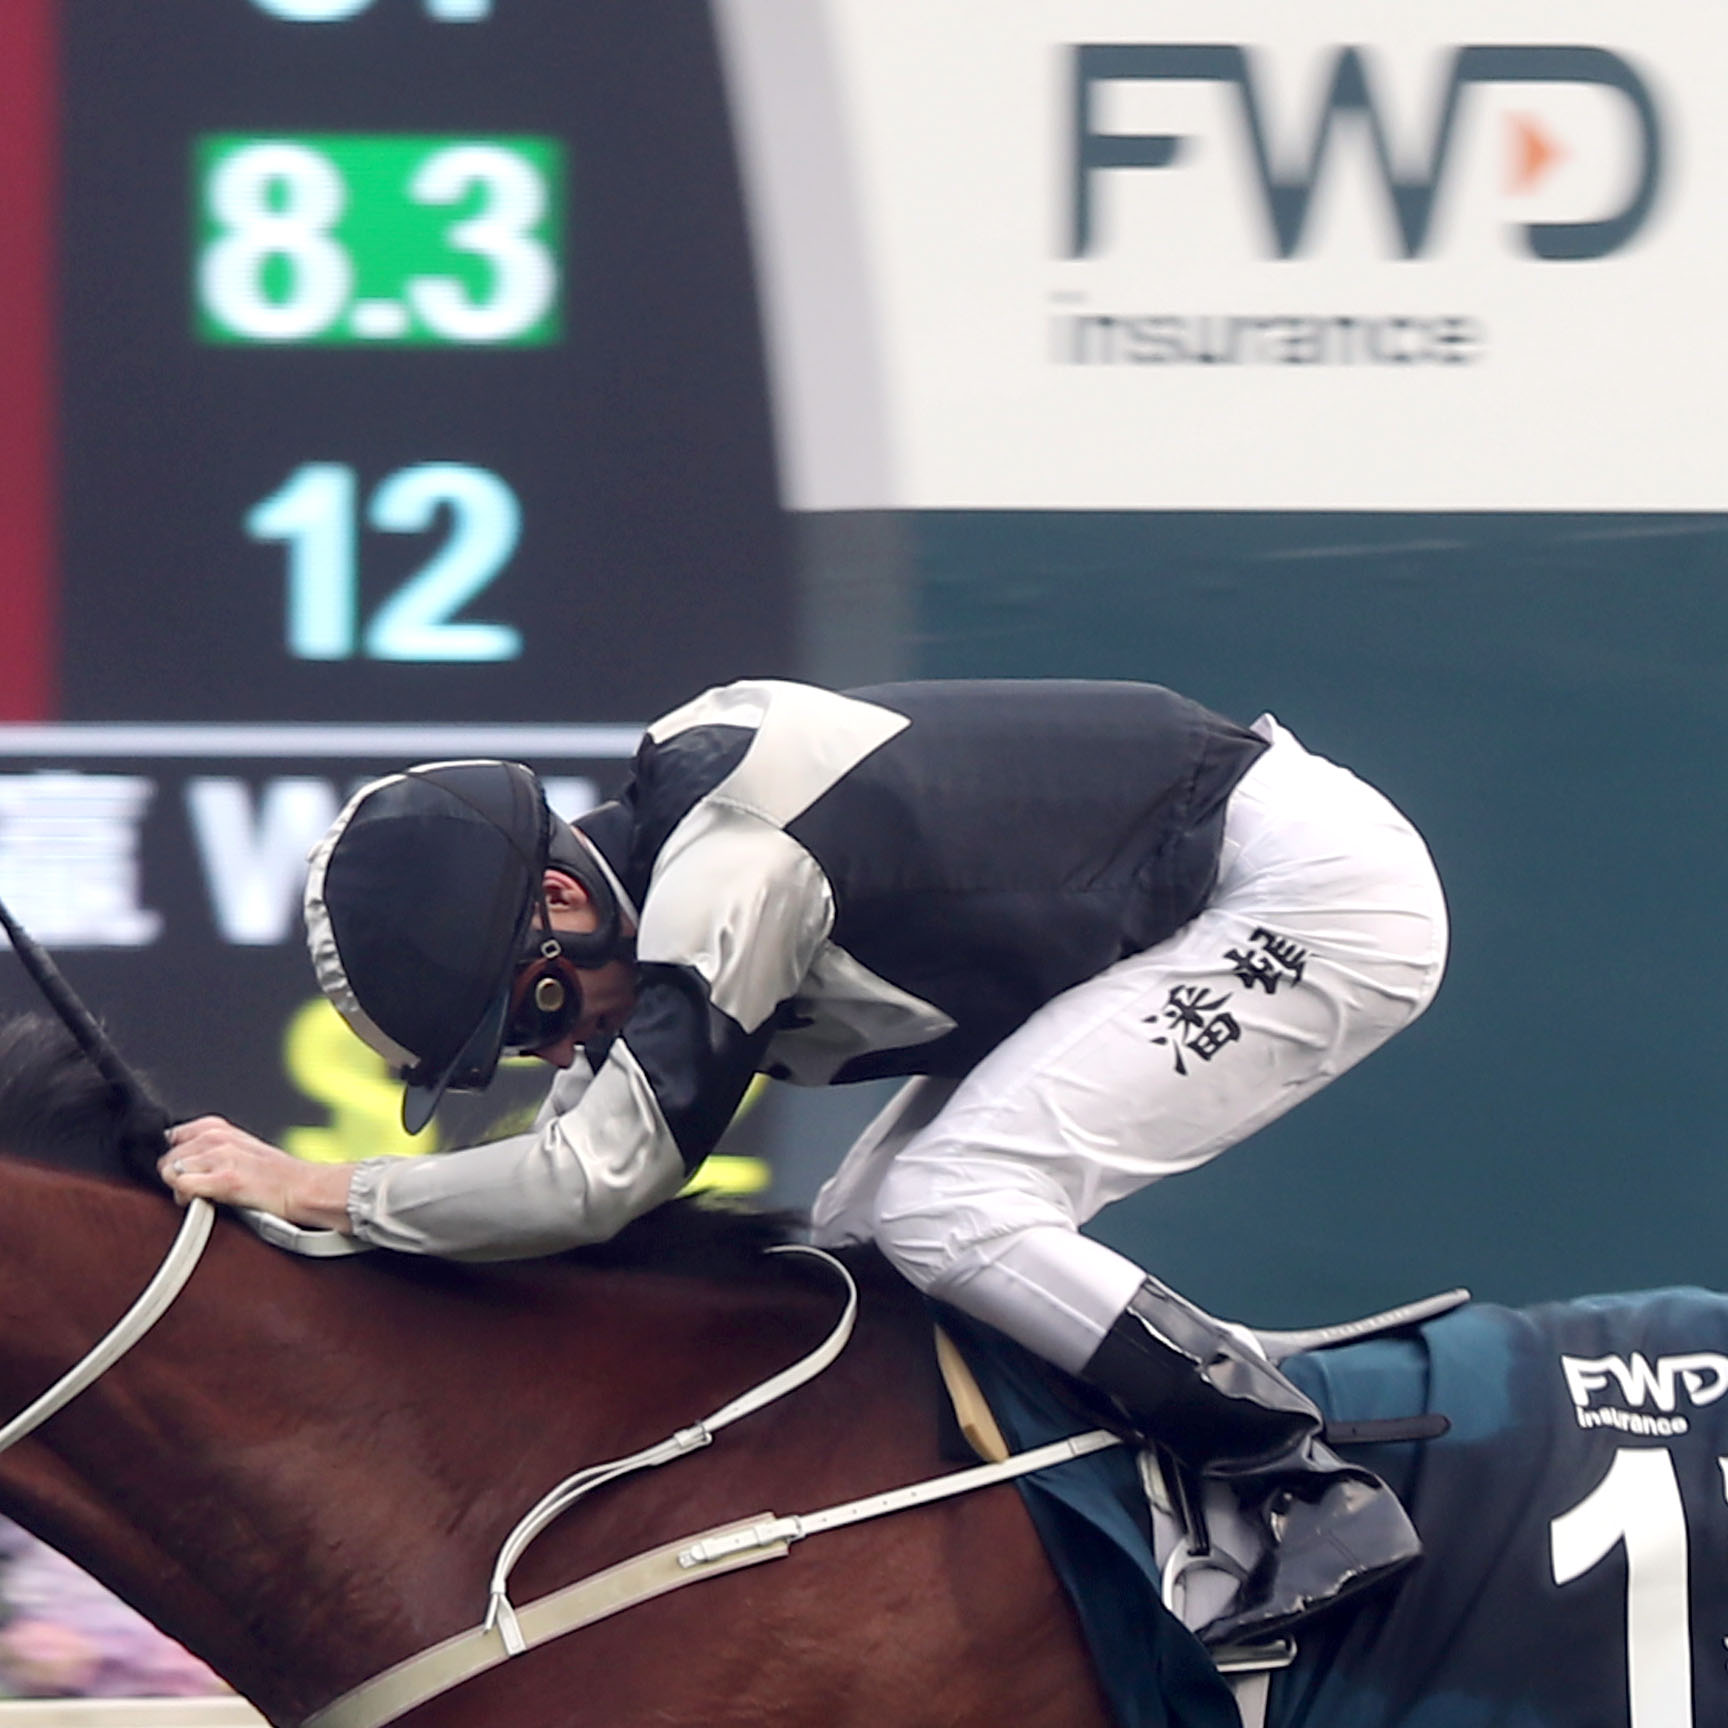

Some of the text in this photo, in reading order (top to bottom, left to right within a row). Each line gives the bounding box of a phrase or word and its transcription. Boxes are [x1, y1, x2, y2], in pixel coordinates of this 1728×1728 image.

[199, 140, 557, 342] 8.3
[1055, 43, 1674, 261] FWD
[1048, 290, 1486, 365] insurance
[245, 462, 523, 662] 12
[1575, 1405, 1689, 1436] insurance
